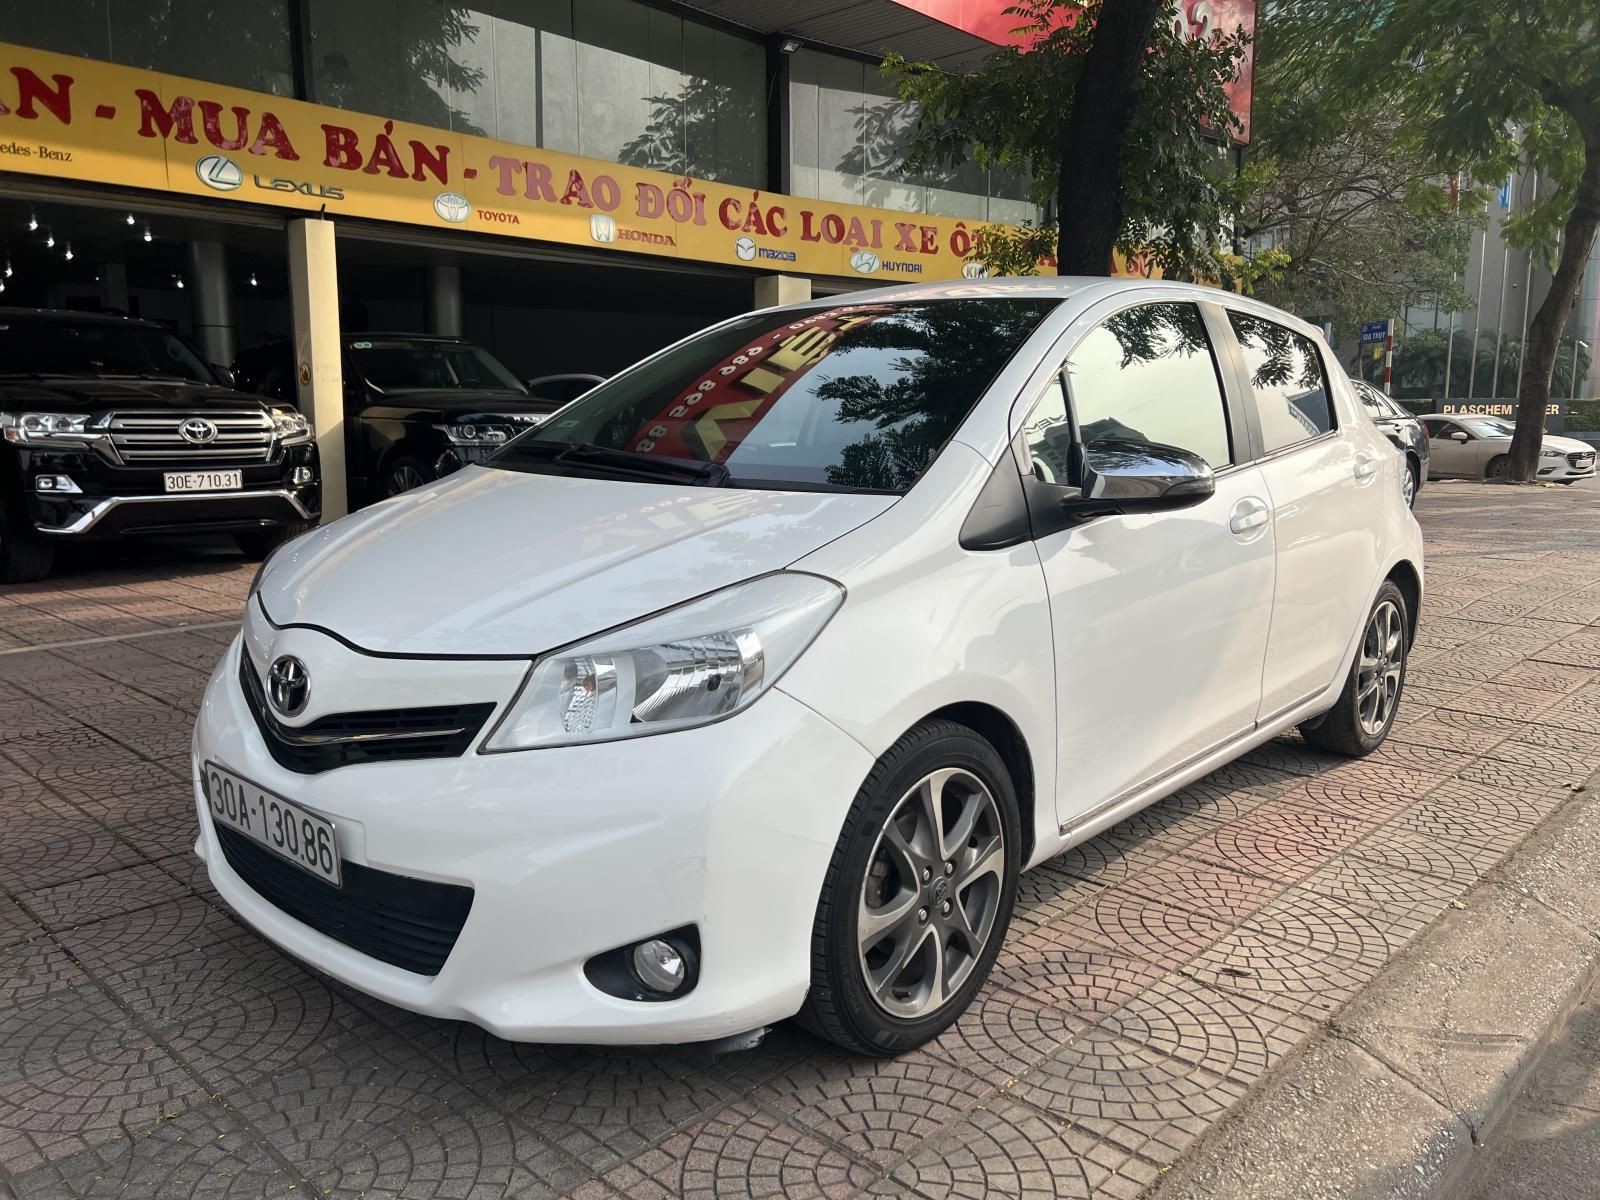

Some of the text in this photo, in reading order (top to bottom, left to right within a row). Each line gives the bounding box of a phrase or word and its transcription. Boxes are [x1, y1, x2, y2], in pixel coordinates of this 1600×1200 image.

[0, 66, 75, 125] N
[134, 88, 301, 162] MUA
[319, 119, 452, 186] BÁN
[488, 155, 622, 212] TRAO
[635, 177, 708, 226] ĐỔI
[718, 190, 788, 238] CÁC
[799, 209, 882, 253] LOẠI
[894, 222, 940, 255] XE
[253, 174, 345, 201] LEXUS
[476, 208, 521, 226] TOYOTA
[616, 227, 677, 247] HONDA
[881, 260, 923, 274] HUYNDAI
[1443, 404, 1512, 415] PLASCHEM
[166, 473, 240, 491] 30E-710.31
[209, 770, 334, 876] 30A-130.86
